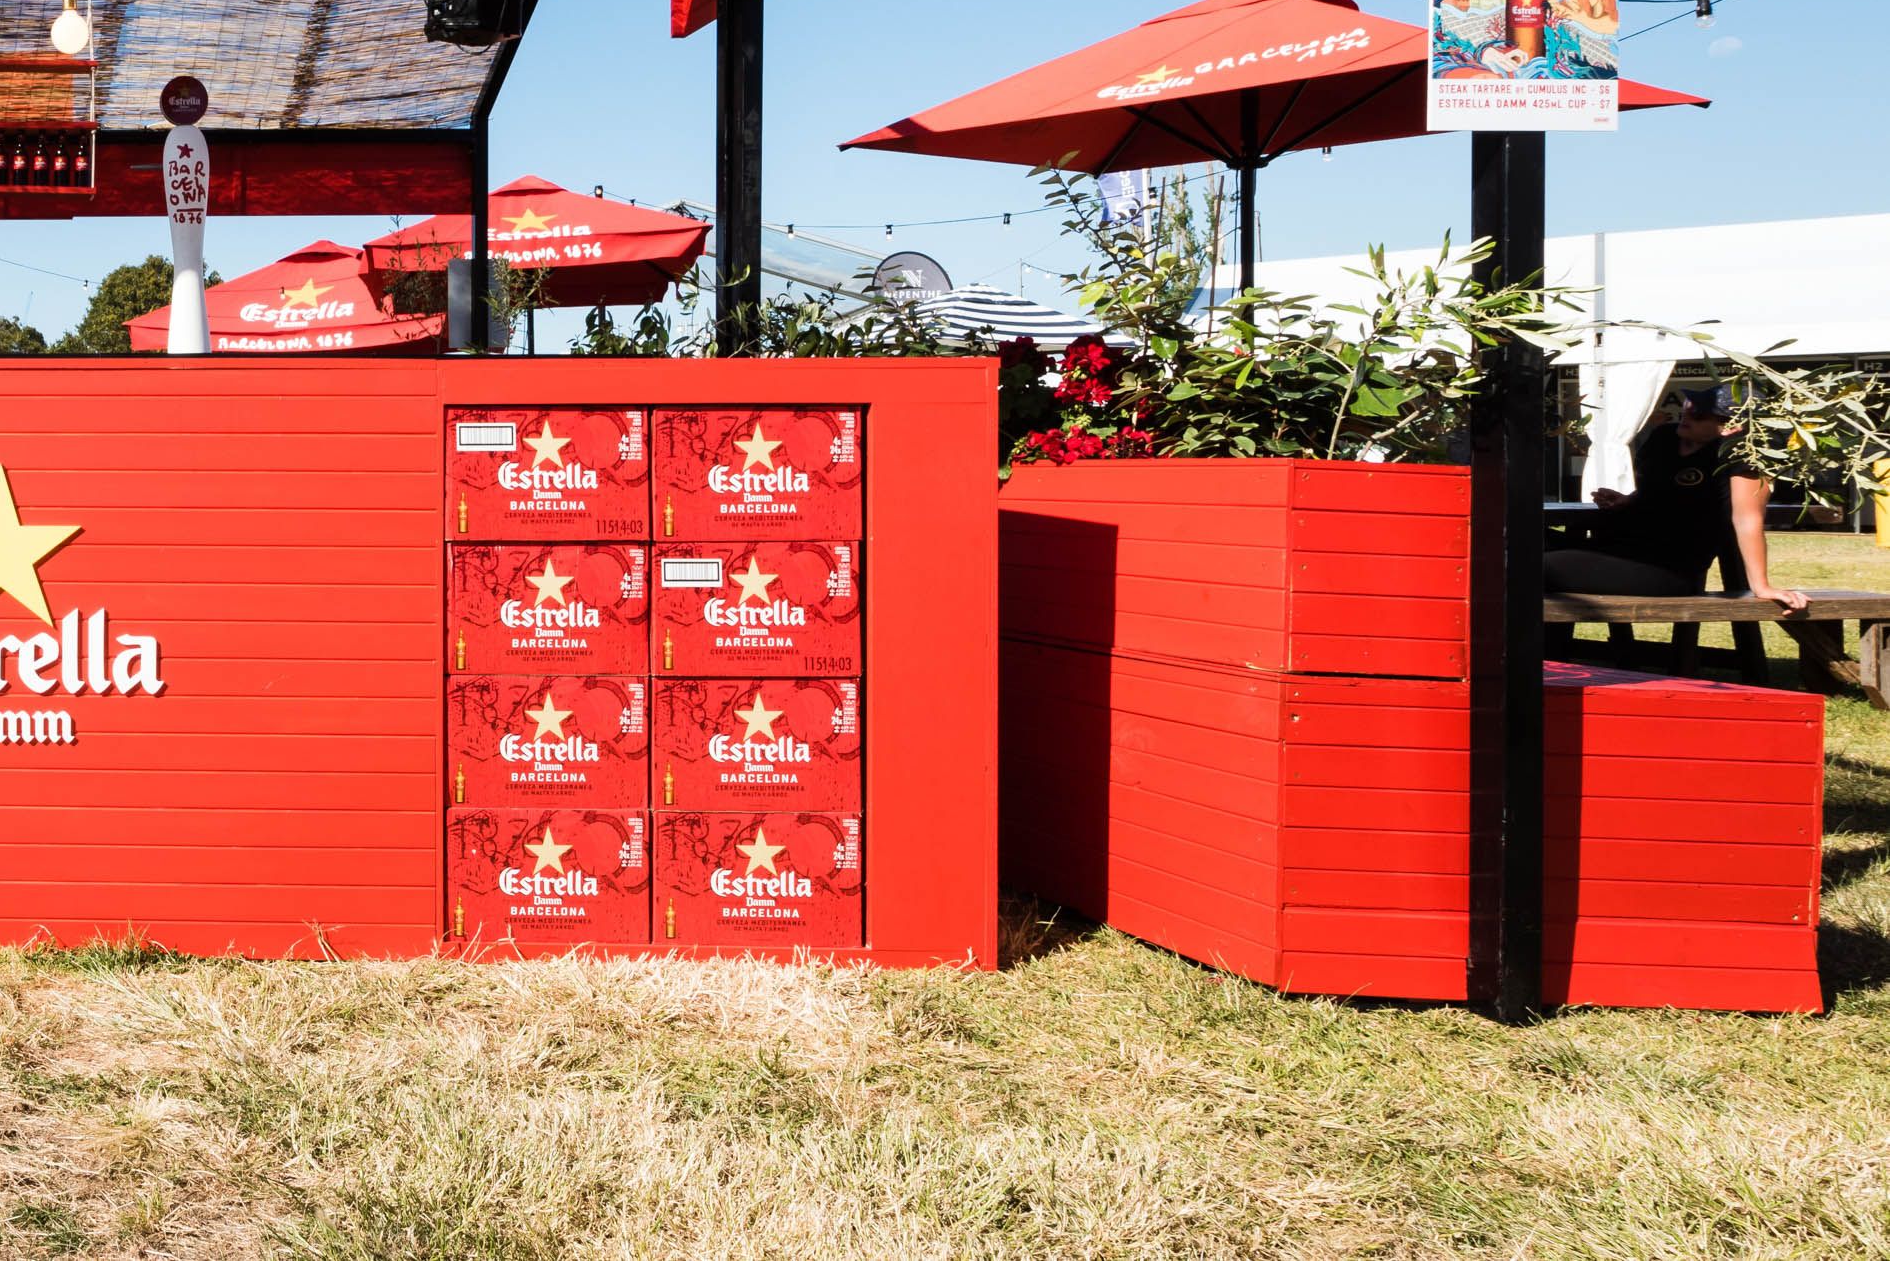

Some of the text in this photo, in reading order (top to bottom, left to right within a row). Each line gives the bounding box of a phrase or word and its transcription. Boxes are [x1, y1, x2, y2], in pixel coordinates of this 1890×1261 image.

[1195, 28, 1366, 74] BARCELONA
[1439, 85, 1468, 94] STEAK
[1472, 85, 1511, 94] TARTARE
[1528, 85, 1567, 94] CUMULUS
[1572, 85, 1587, 94] INC
[1600, 84, 1610, 94] $6
[169, 97, 201, 106] Estrella
[1439, 100, 1490, 109] ESTRELLA
[1497, 100, 1527, 109] DAMM
[1568, 100, 1587, 109] CUP
[1600, 100, 1610, 109] $7
[168, 160, 205, 177] BAR
[173, 212, 202, 224] 1876
[564, 242, 602, 258] 1876
[884, 290, 942, 299] NEPENTHE
[240, 301, 355, 322] Estrella
[316, 331, 353, 347] 1876
[498, 460, 598, 490] Estrella
[708, 464, 809, 494] Estrella
[532, 490, 562, 500] Damm
[743, 492, 773, 502] Damm
[509, 500, 586, 510] BARCELONA
[720, 504, 797, 513] BARCELONA
[501, 598, 600, 628] Estrella
[704, 596, 805, 626] Estrella
[535, 628, 564, 638] Damm
[739, 626, 769, 636] Damm
[511, 638, 588, 648] BARCELONA
[716, 636, 793, 646] BARCELONA
[500, 732, 599, 762] Estrella
[709, 734, 811, 764] Estrella
[534, 760, 563, 770] Damm
[744, 762, 774, 772] Damm
[511, 772, 586, 781] BARCELONA
[720, 774, 798, 783] BARCELONA
[499, 866, 598, 896] Estrella
[711, 868, 812, 898] Estrella
[533, 894, 562, 904] Damm
[746, 896, 776, 906] Damm
[510, 906, 586, 915] BARCELONA
[722, 908, 800, 917] BARCELONA
